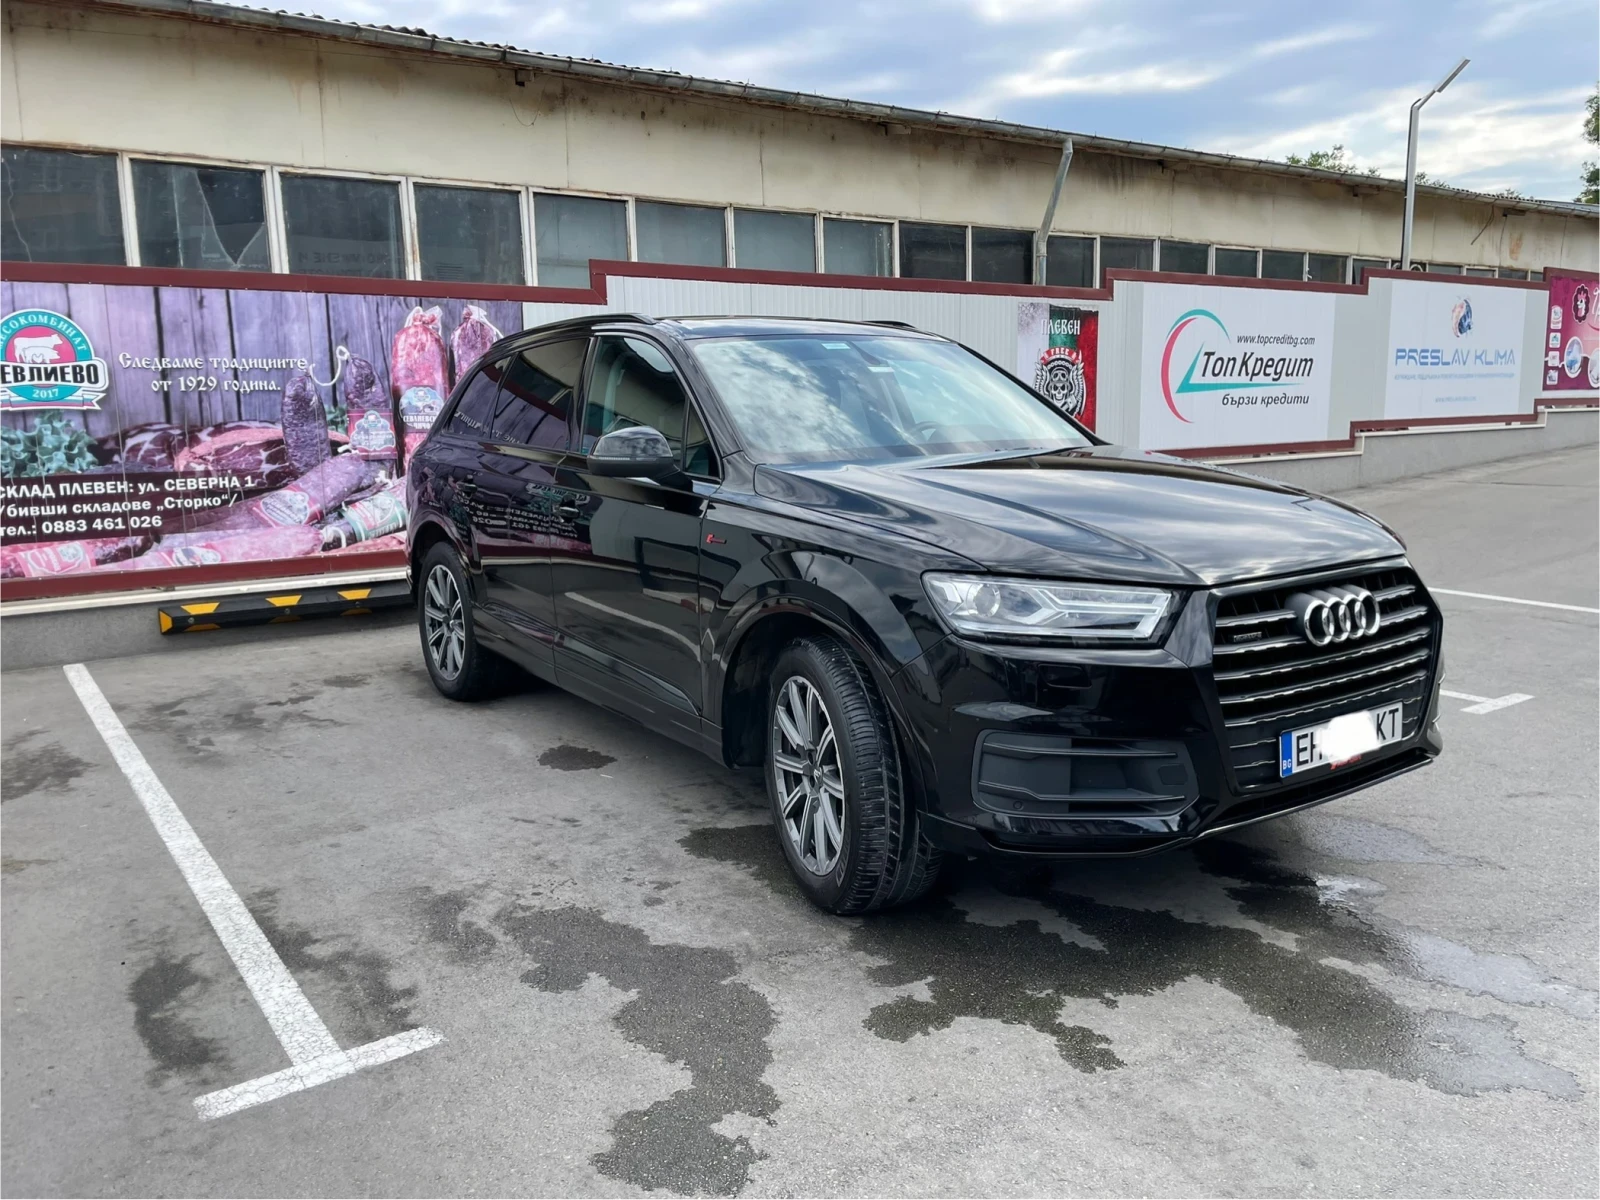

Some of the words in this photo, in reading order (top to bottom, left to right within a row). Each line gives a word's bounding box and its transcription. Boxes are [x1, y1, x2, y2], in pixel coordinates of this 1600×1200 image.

[1041, 319, 1080, 335] ПЛЕВЕН
[1237, 334, 1315, 347] www.topcreditbg.com
[118, 352, 204, 371] Следваме
[209, 356, 308, 373] традициите
[1395, 348, 1470, 366] PRESLAV
[1474, 348, 1515, 366] KLIMA
[1201, 351, 1237, 377] Топ
[1238, 351, 1314, 382] Кредит
[151, 379, 172, 391] от
[178, 376, 217, 391] 1929
[223, 380, 281, 393] година.
[32, 388, 59, 398] 2017
[1222, 393, 1258, 408] бързи
[1260, 392, 1310, 408] кредити
[1, 484, 56, 499] СКЛАД
[59, 481, 134, 496] ПЛЕВЕН:
[138, 482, 160, 495] ул.
[164, 477, 240, 491] СЕВЕРНА
[244, 475, 255, 488] 1
[72, 500, 151, 513] складове
[42, 519, 87, 534] 0883
[92, 517, 125, 530] 461
[130, 515, 162, 528] 026
[1282, 758, 1292, 770] BG
